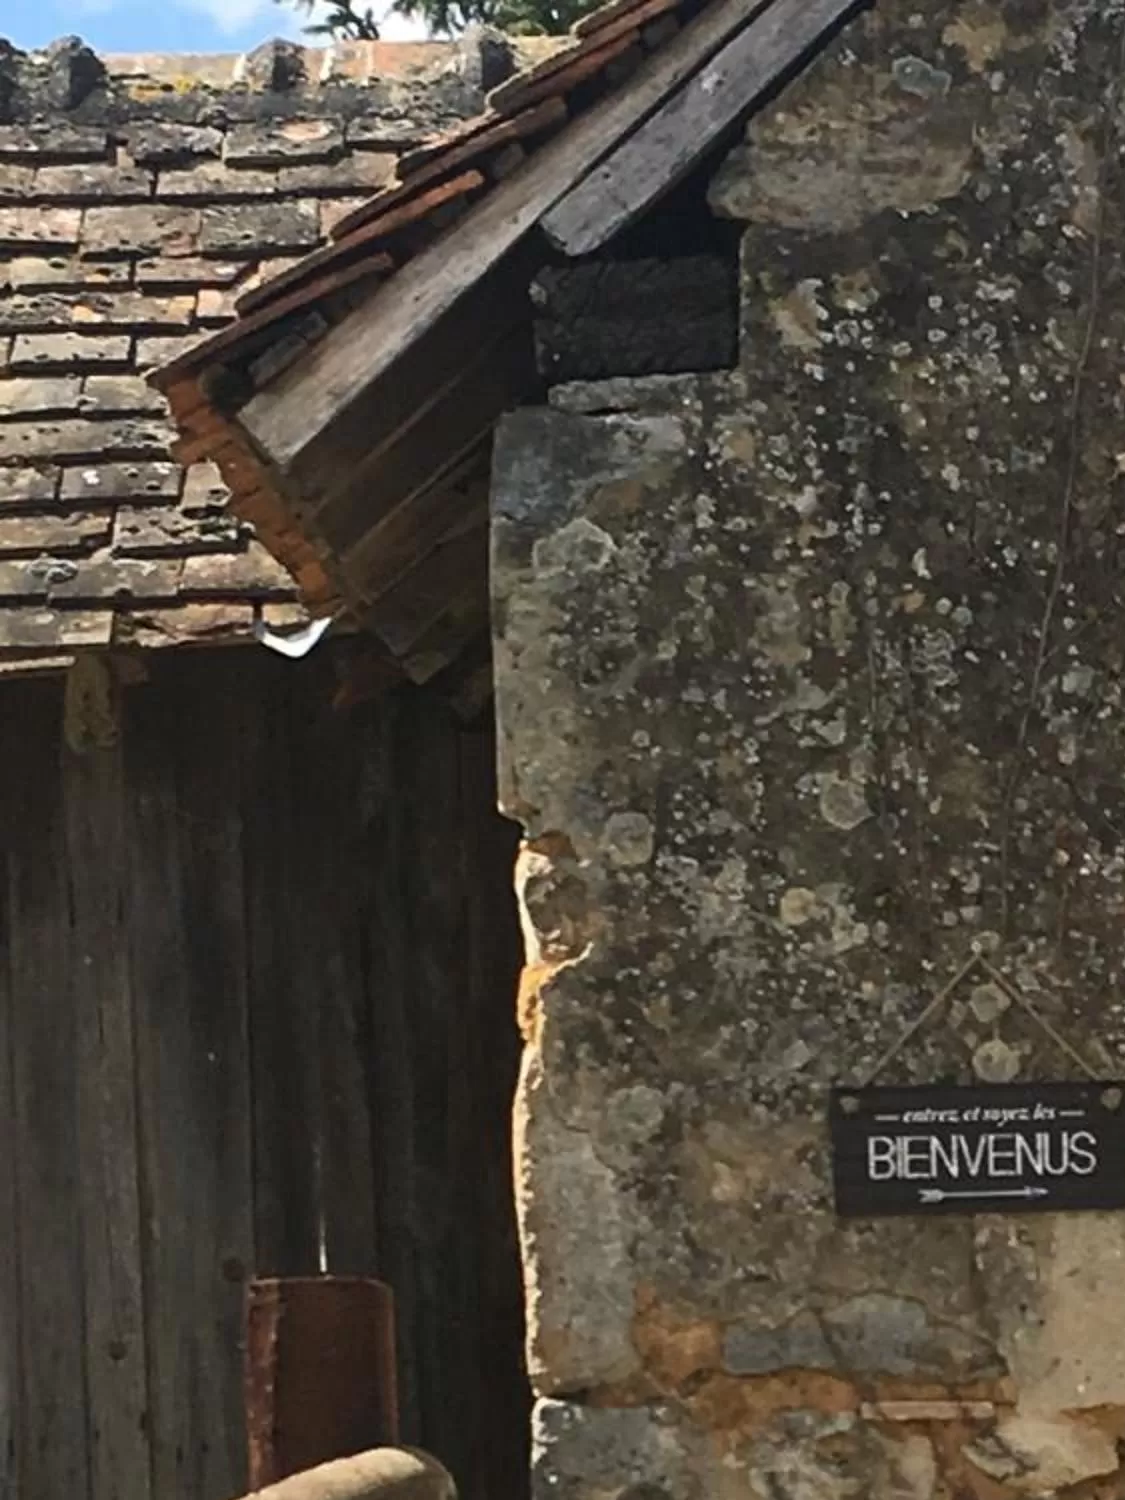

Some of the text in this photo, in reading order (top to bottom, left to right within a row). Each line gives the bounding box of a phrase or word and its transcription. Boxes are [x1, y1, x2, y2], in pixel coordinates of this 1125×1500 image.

[902, 1103, 1056, 1127] entrez et soyez les
[868, 1131, 1097, 1180] BIENVENUS
